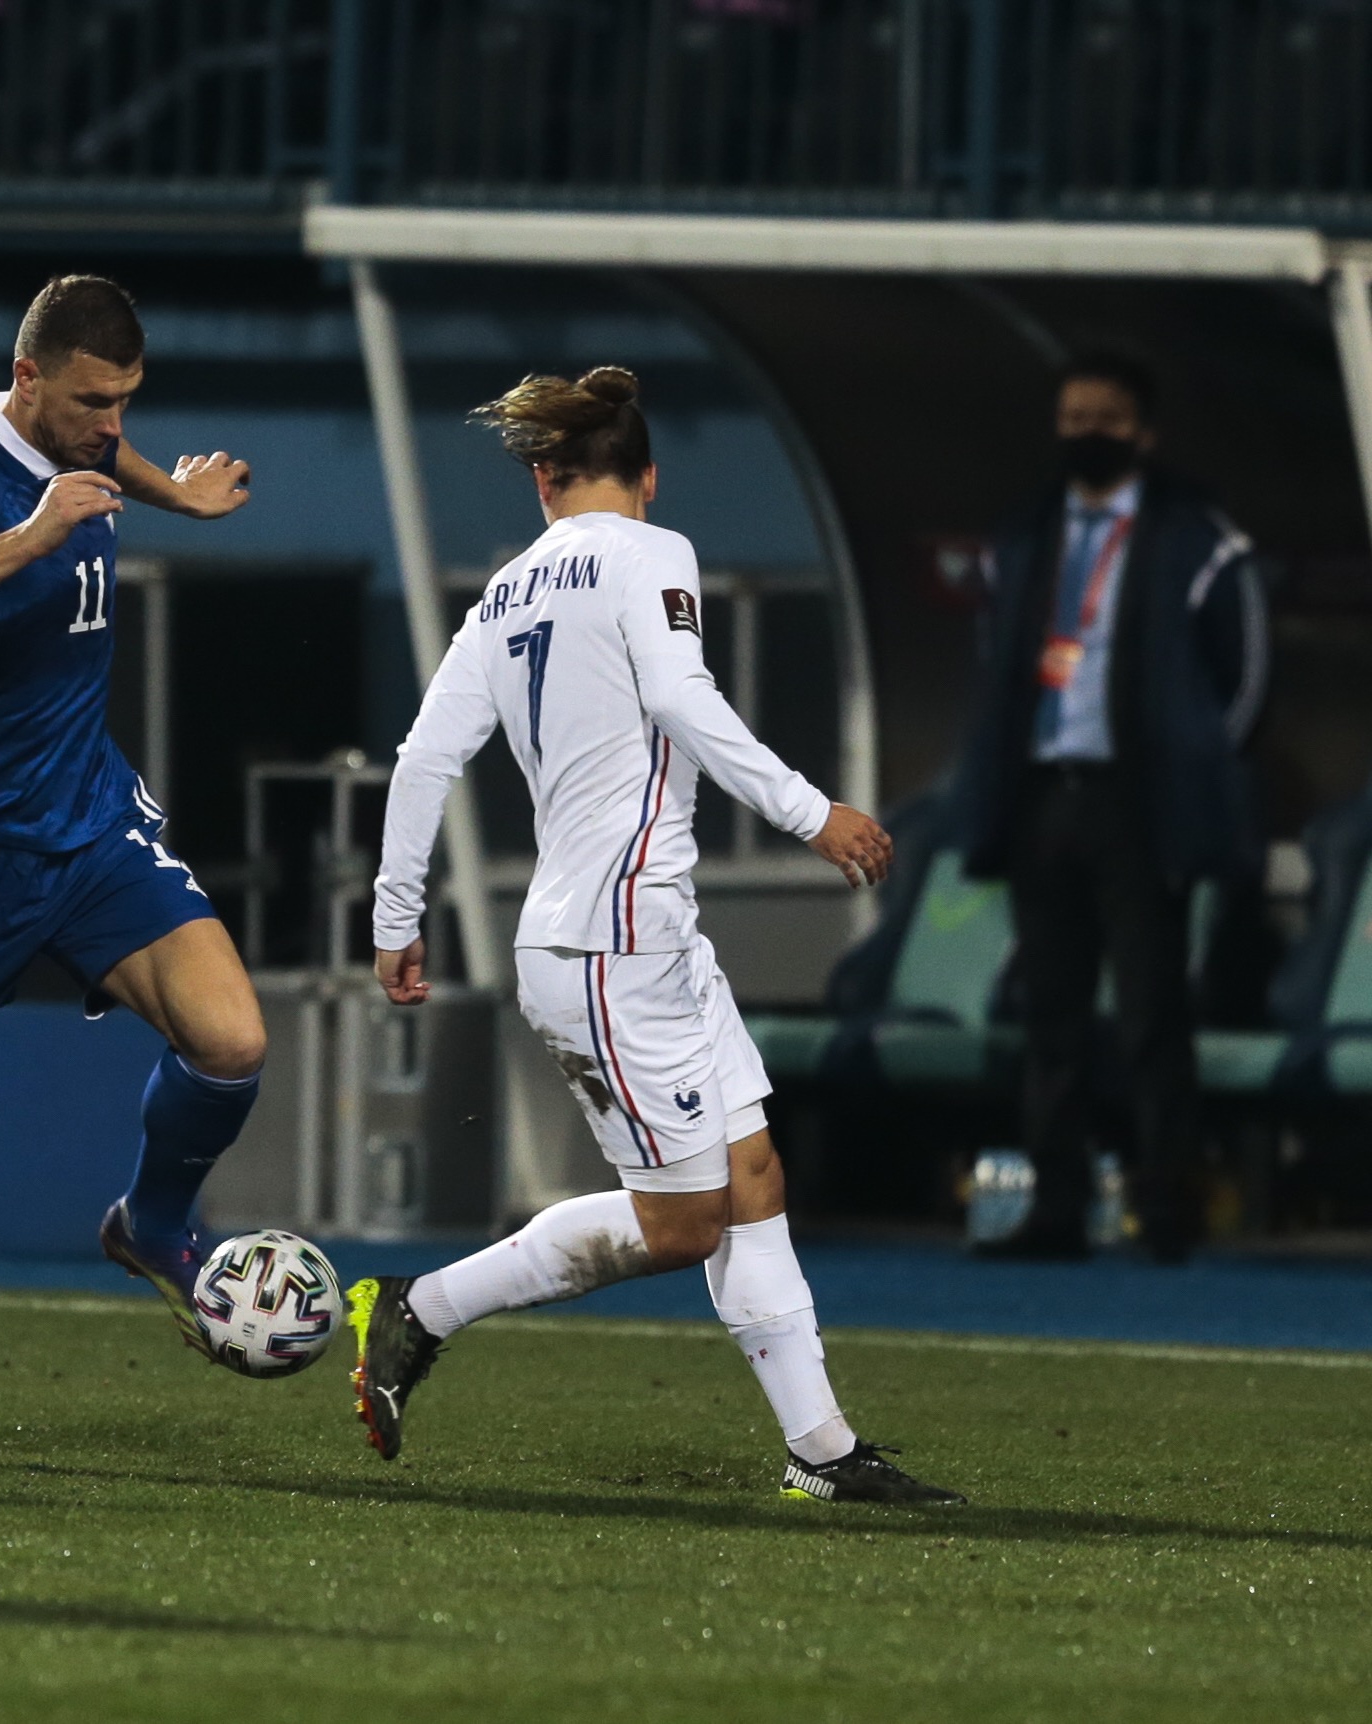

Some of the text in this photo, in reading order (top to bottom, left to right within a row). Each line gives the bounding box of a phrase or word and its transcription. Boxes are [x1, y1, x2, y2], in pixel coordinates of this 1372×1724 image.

[69, 556, 107, 634] 11
[506, 619, 554, 769] 7
[783, 1464, 836, 1500] PUMA
